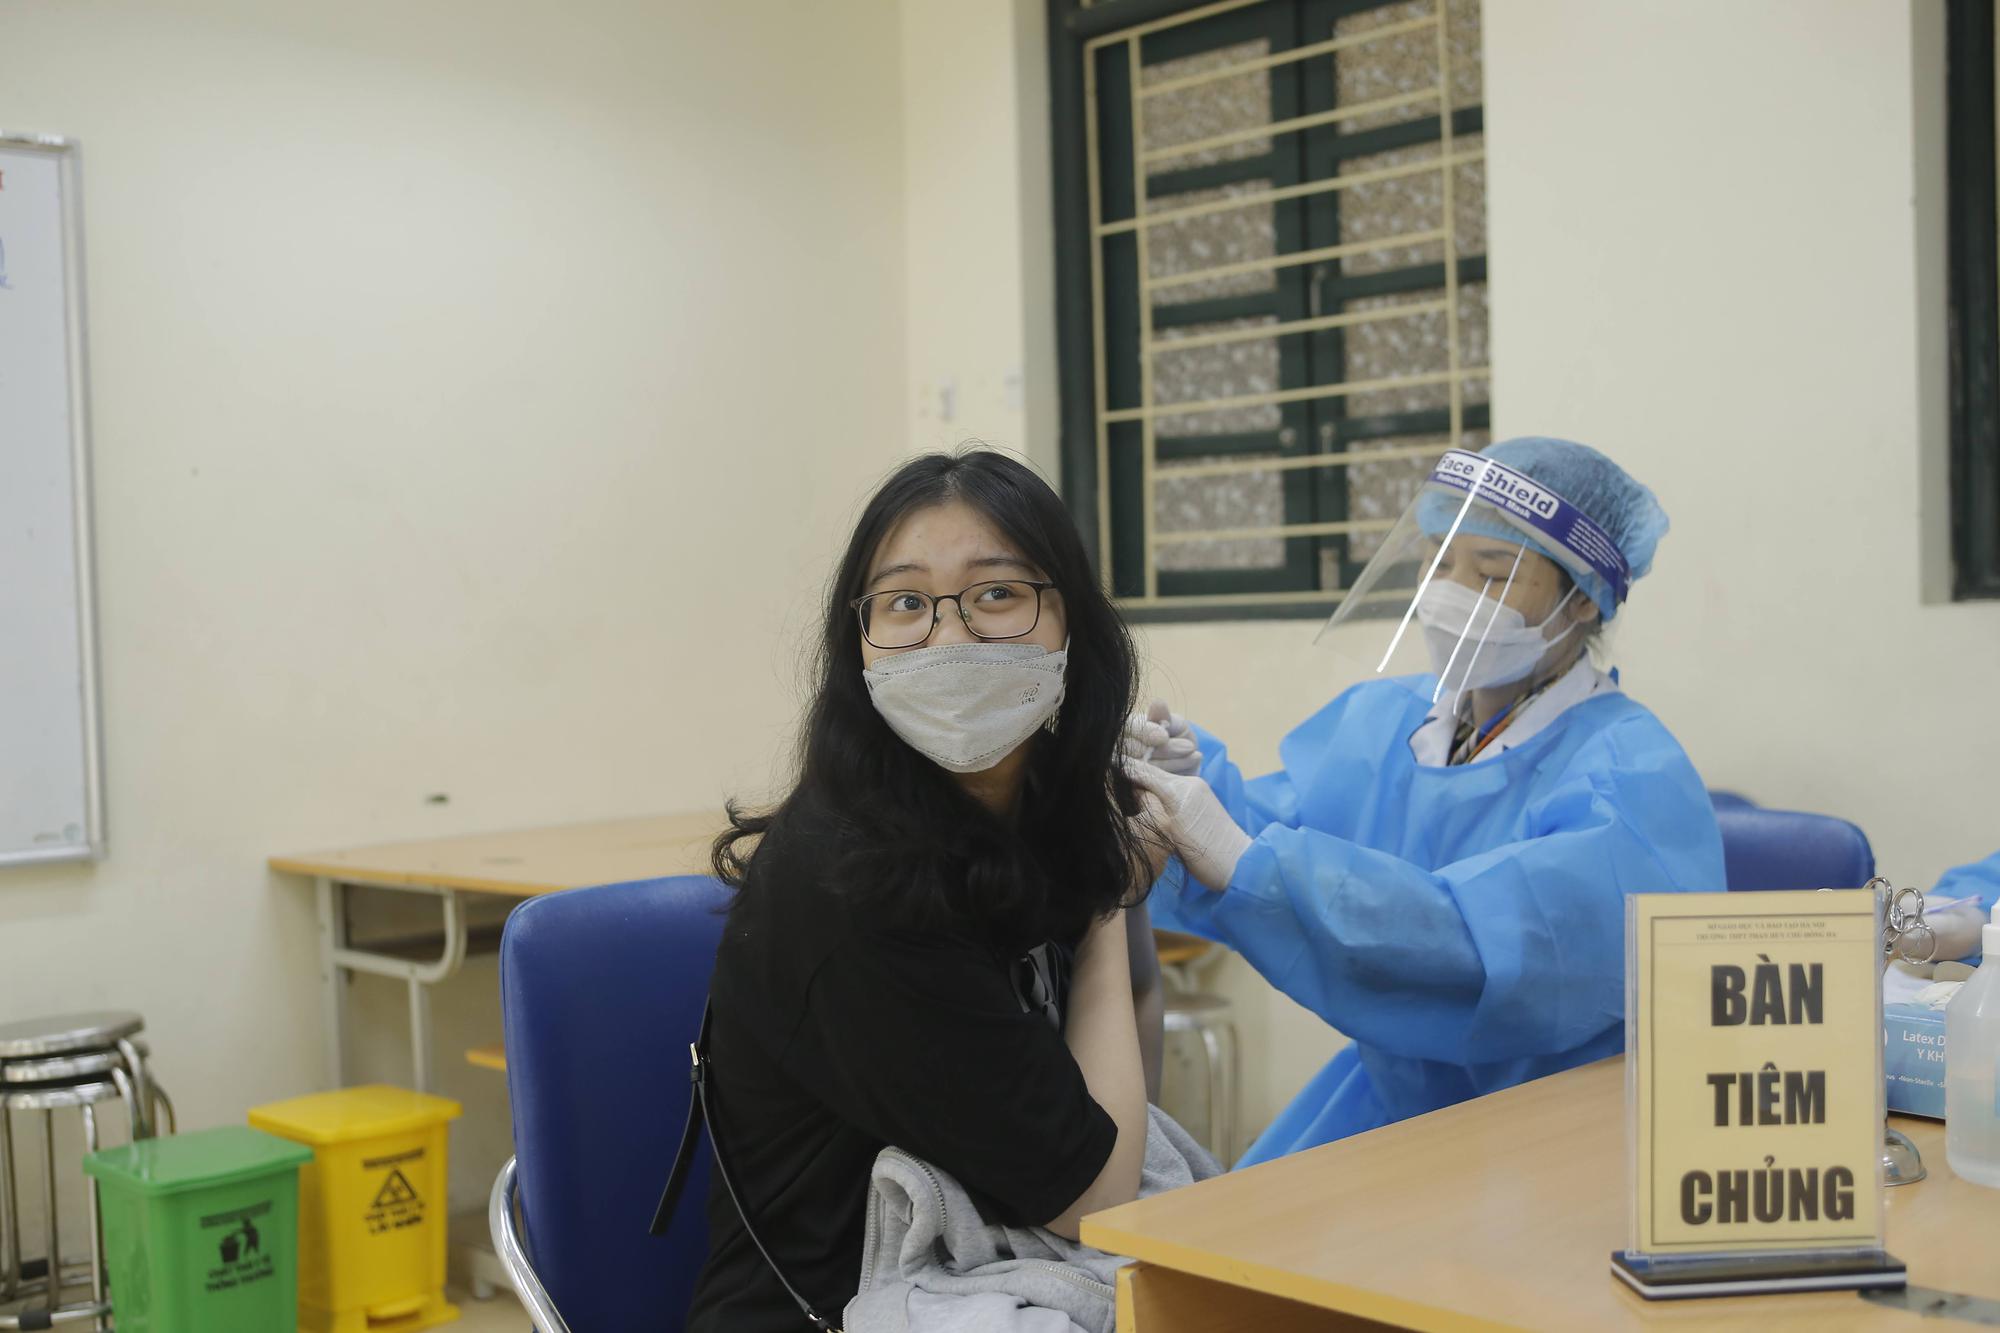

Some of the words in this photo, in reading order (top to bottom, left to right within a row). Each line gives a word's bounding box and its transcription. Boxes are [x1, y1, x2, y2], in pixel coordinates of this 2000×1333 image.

[1438, 456, 1475, 476] Face
[1482, 468, 1554, 515] Shield
[1711, 954, 1824, 1027] BÀN
[1903, 1030, 1935, 1045] Latex
[1917, 1048, 1925, 1059] Y
[1706, 1061, 1826, 1127] TIÊM
[1680, 1155, 1854, 1226] CHỦNG
